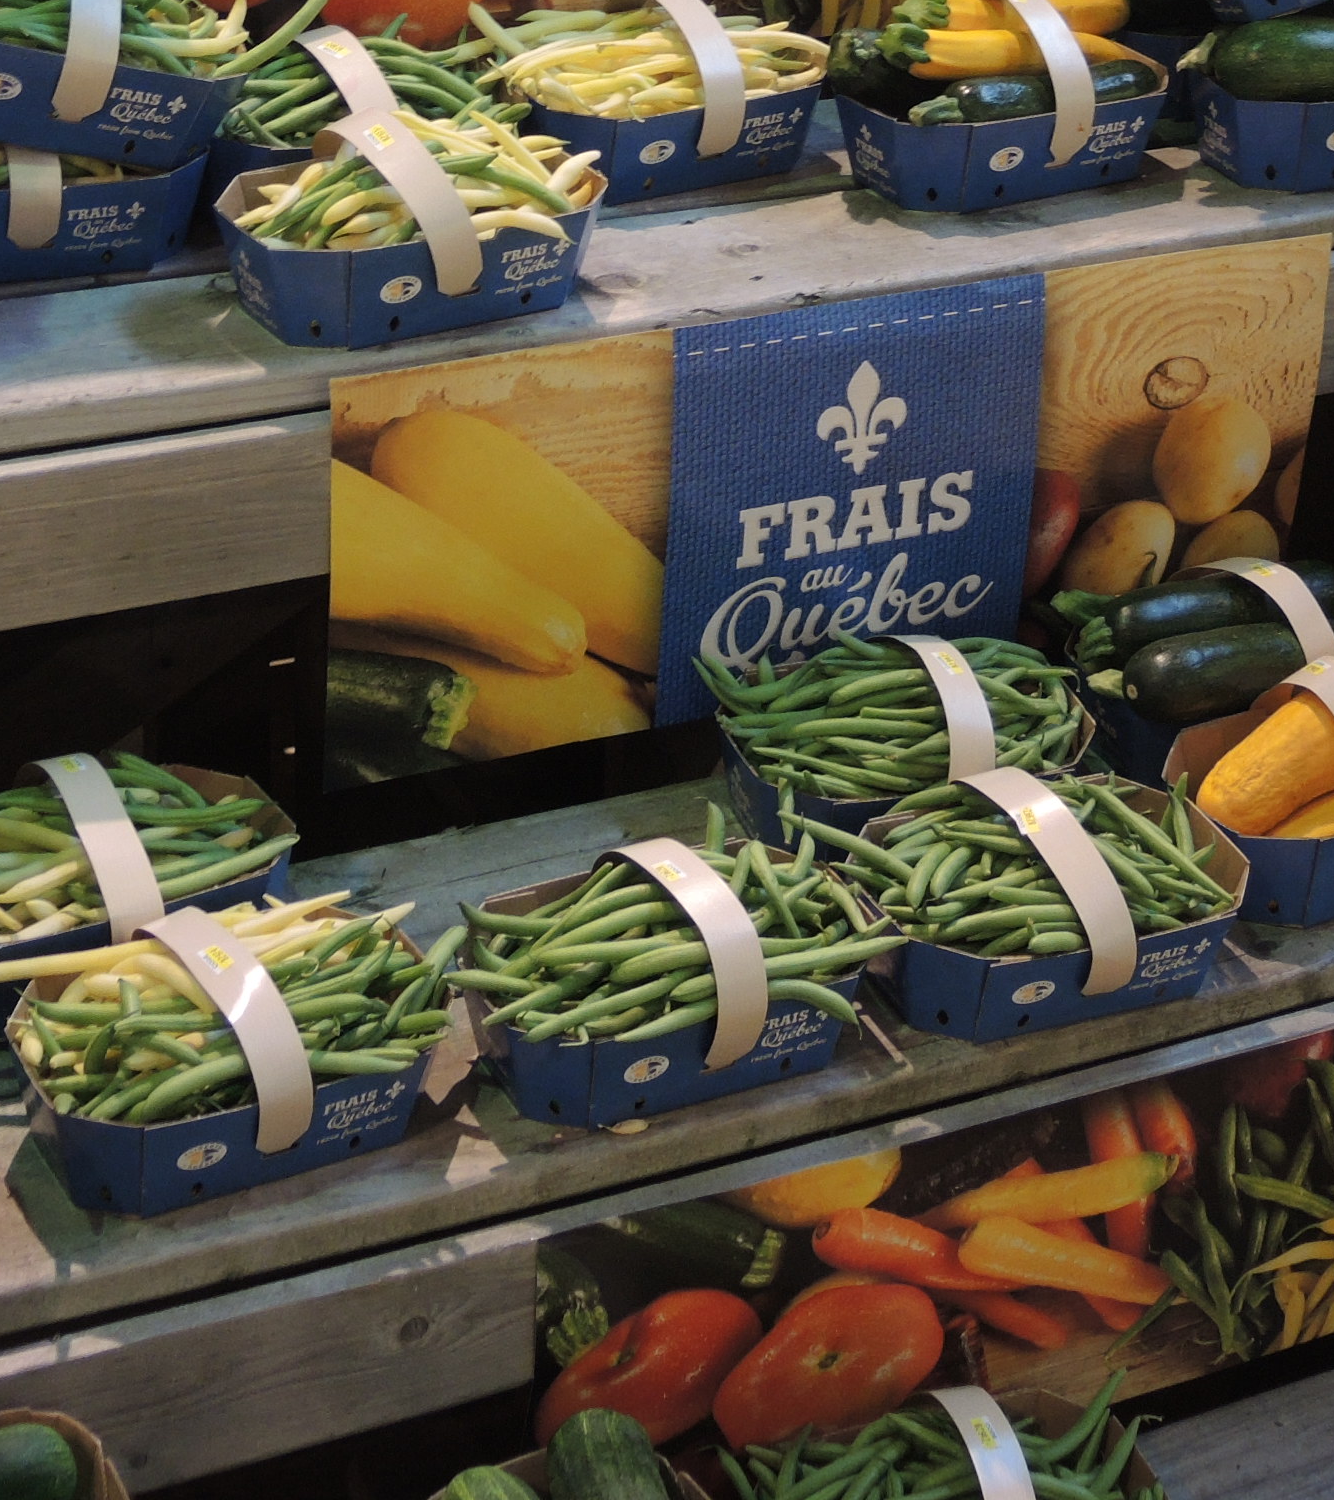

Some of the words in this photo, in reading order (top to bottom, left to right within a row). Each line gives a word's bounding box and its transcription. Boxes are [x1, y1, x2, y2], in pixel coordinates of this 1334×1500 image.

[109, 87, 162, 107] FRAIS
[110, 102, 172, 125] Québec
[67, 205, 118, 220] FRAIS
[72, 219, 135, 240] Québec
[501, 242, 547, 264] FRAIS
[503, 255, 562, 280] Québec
[736, 470, 974, 570] FRAIS
[801, 563, 854, 593] au
[699, 552, 995, 670] Québec
[1140, 943, 1189, 965] FRAIS
[1139, 957, 1198, 979] Québec
[761, 1024, 824, 1049] Québec
